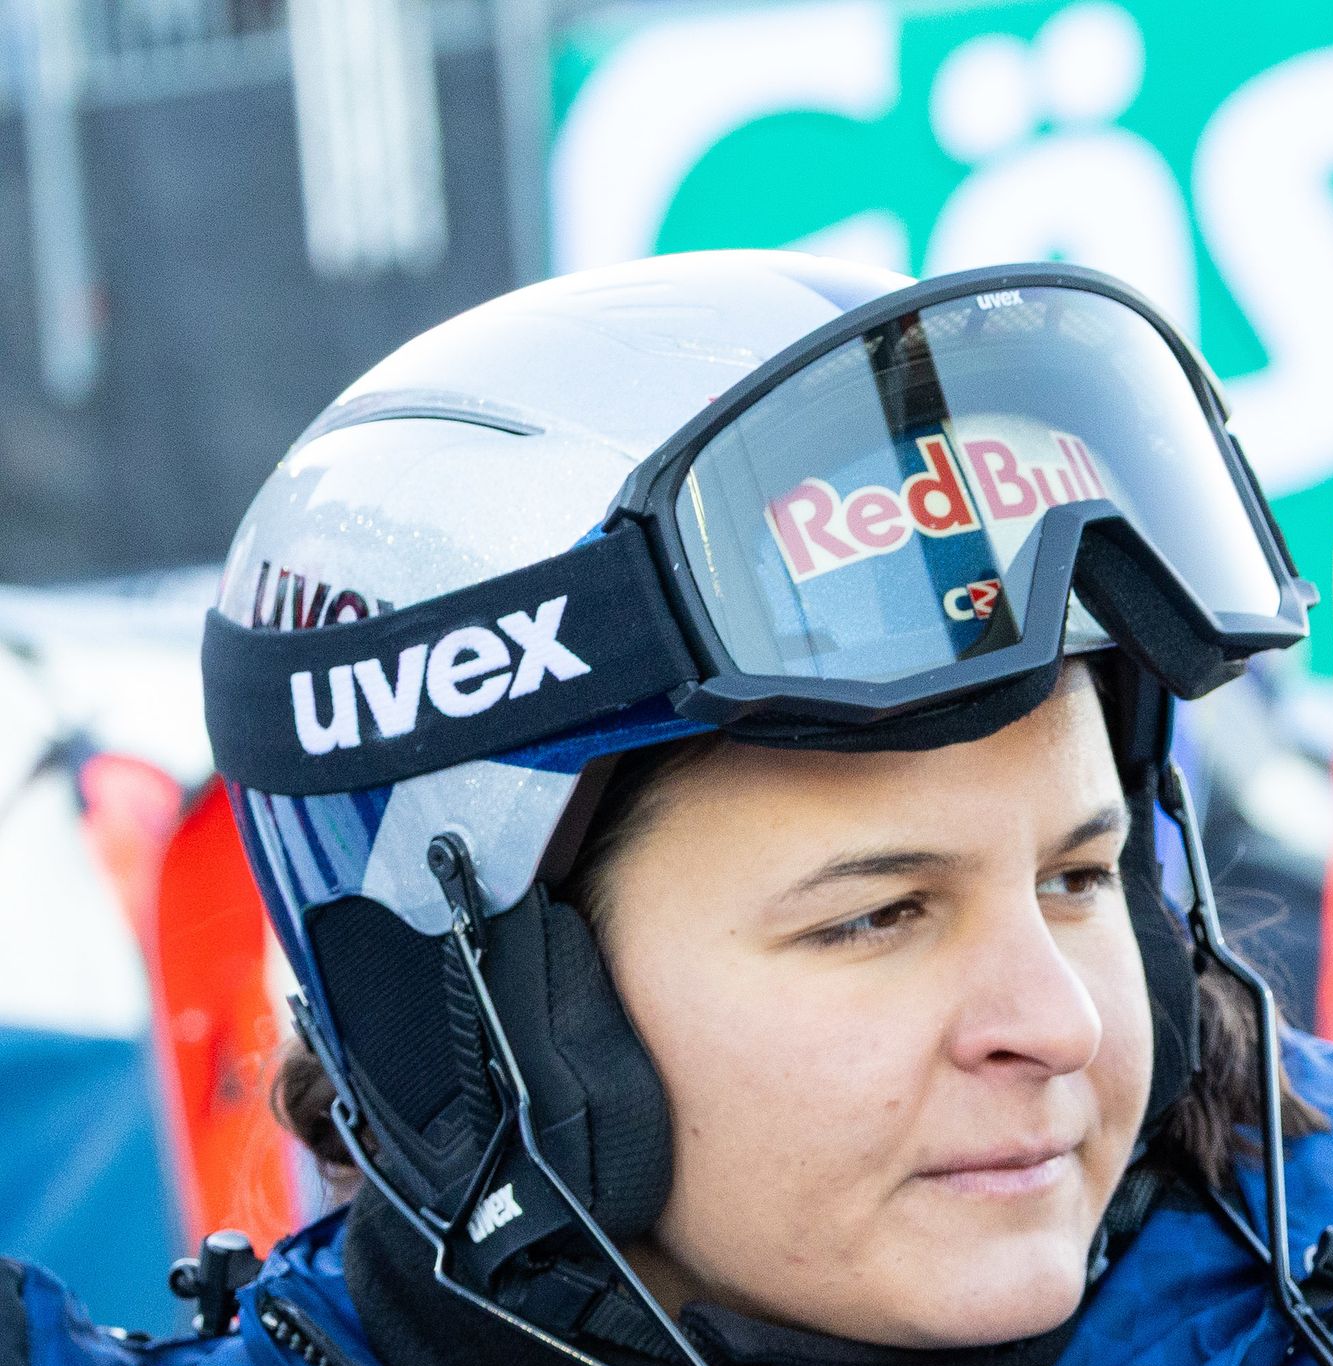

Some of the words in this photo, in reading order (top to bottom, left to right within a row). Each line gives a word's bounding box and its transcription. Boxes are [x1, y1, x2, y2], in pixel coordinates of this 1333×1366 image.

[976, 289, 1024, 311] uvex
[772, 440, 973, 577] Red
[291, 595, 591, 756] uvex
[467, 1182, 523, 1244] uvex
